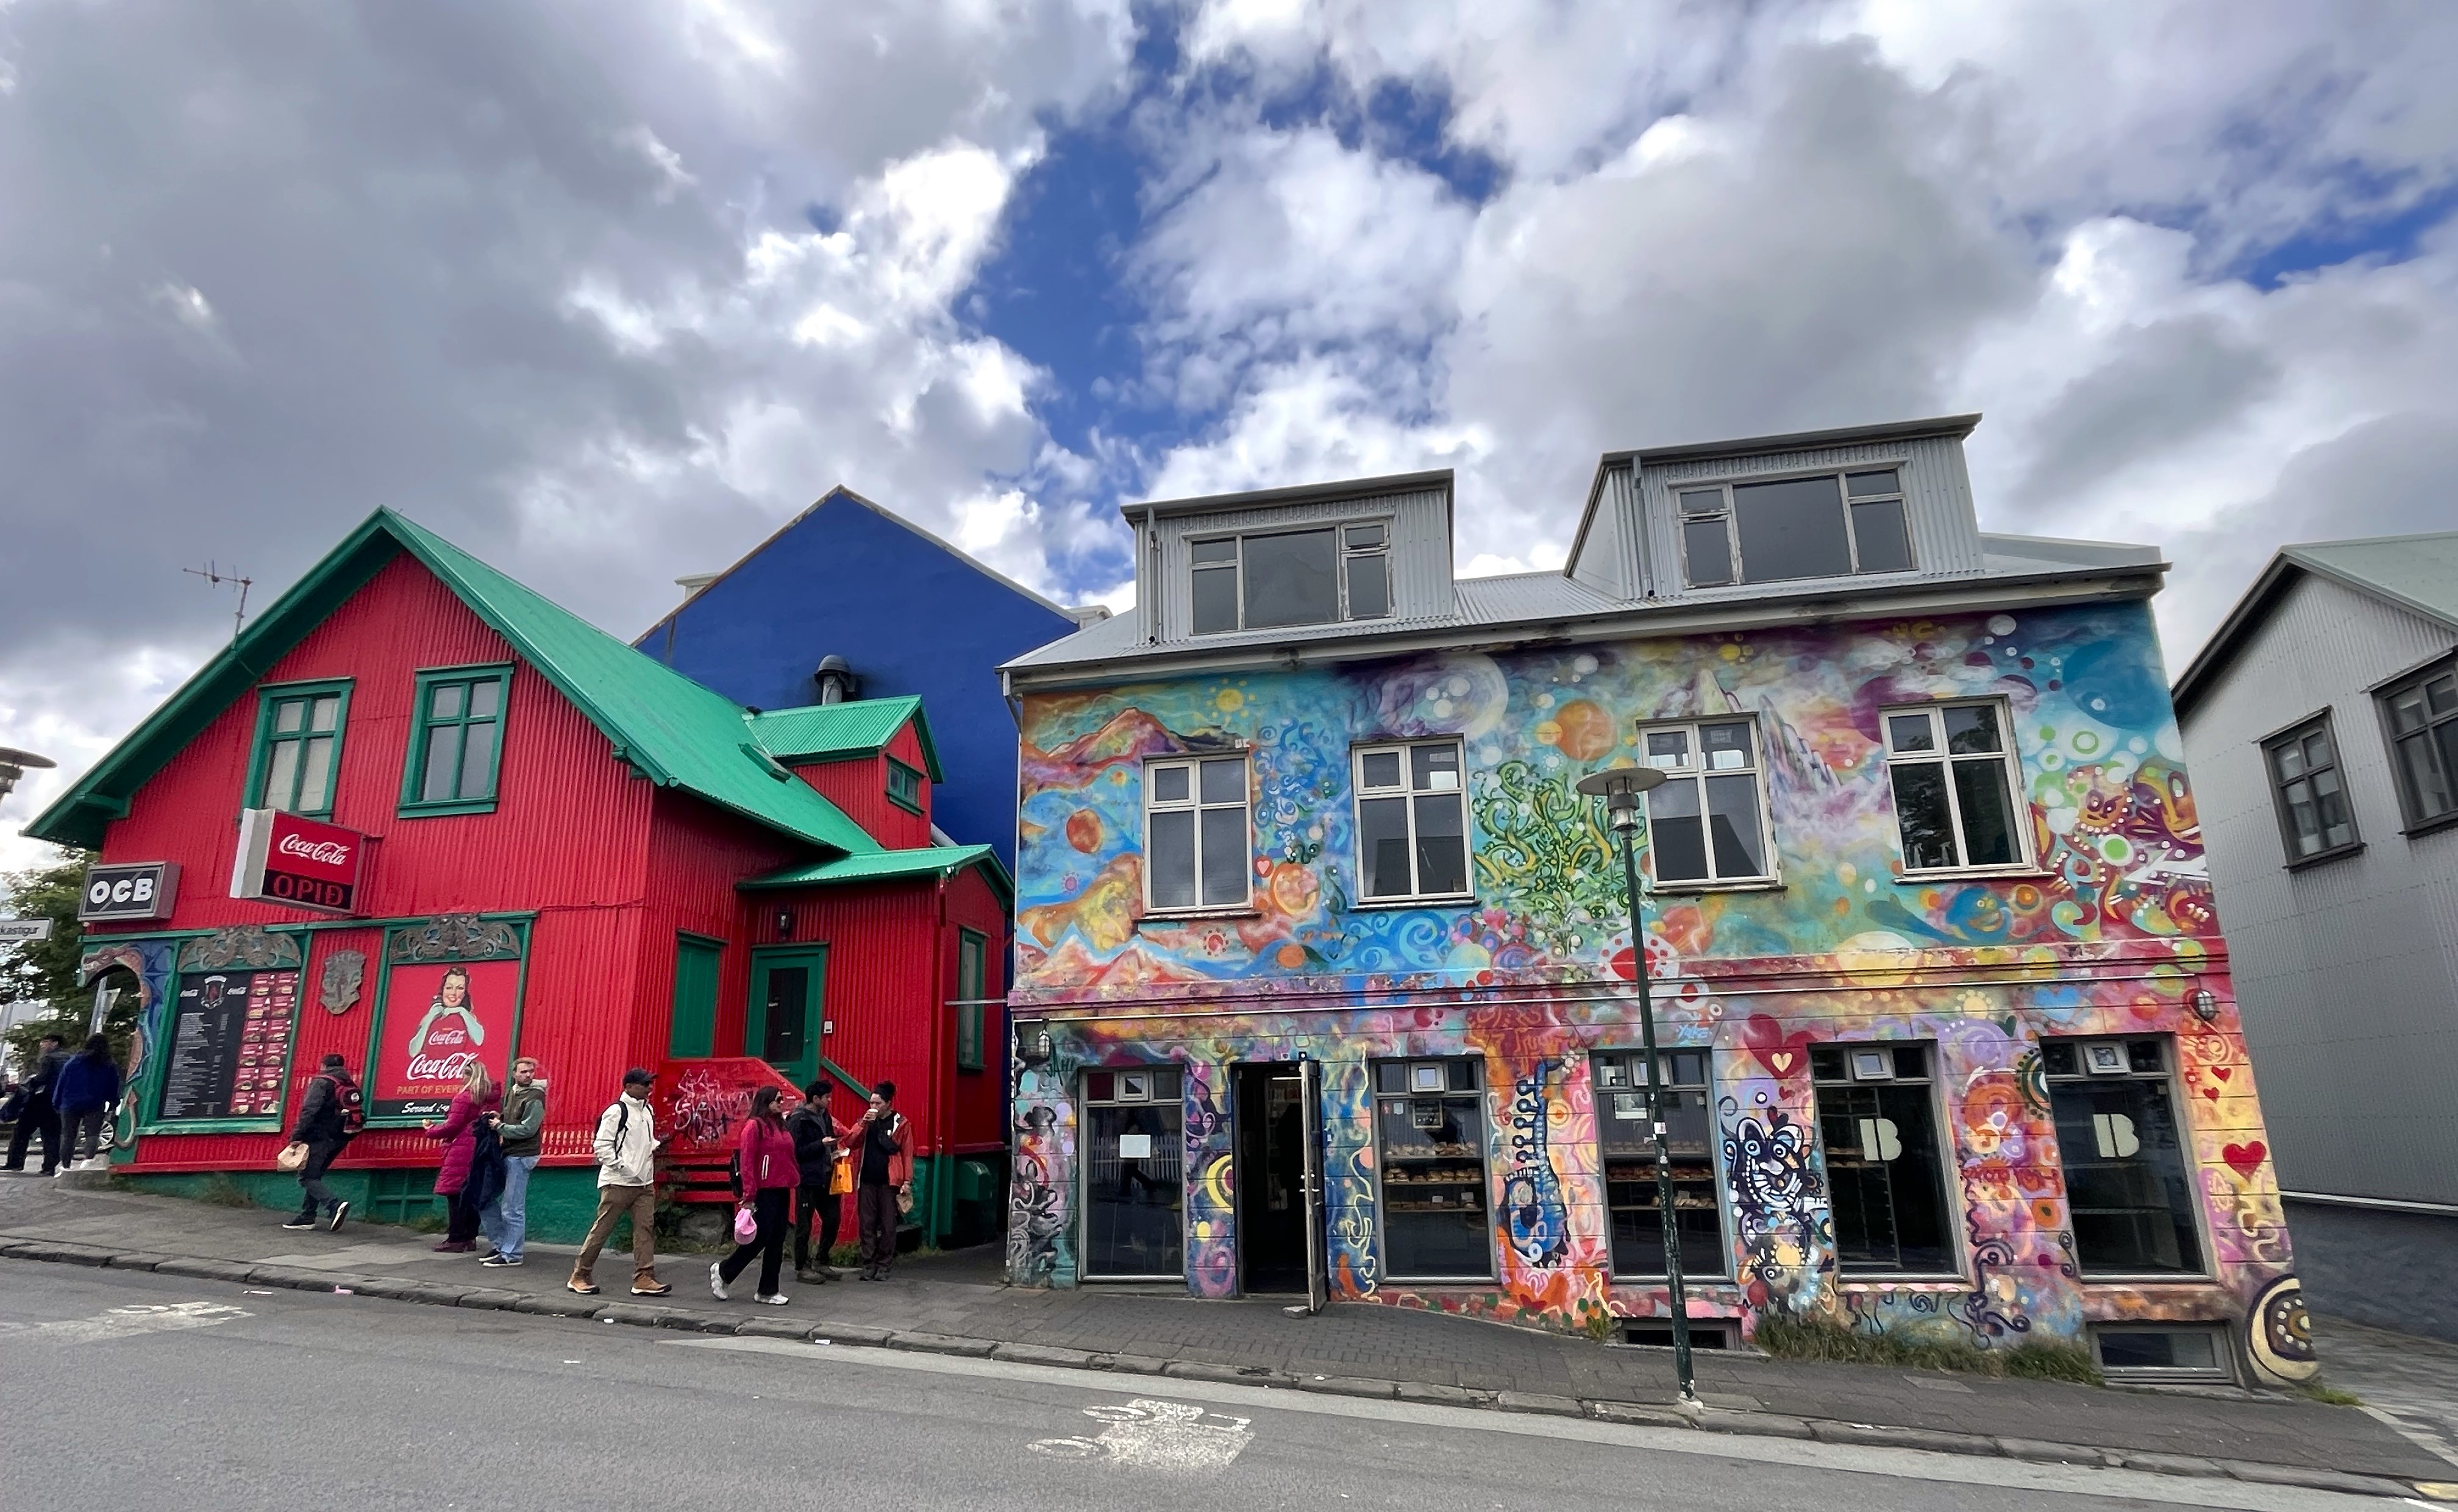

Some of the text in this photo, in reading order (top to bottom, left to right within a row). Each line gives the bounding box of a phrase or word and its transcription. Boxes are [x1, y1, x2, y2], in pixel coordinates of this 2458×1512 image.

[279, 834, 352, 865] Coca-Cola
[90, 878, 154, 904] OCB
[407, 1052, 479, 1080] Coca-Col
[397, 1086, 419, 1095] PART
[421, 1085, 433, 1094] OF
